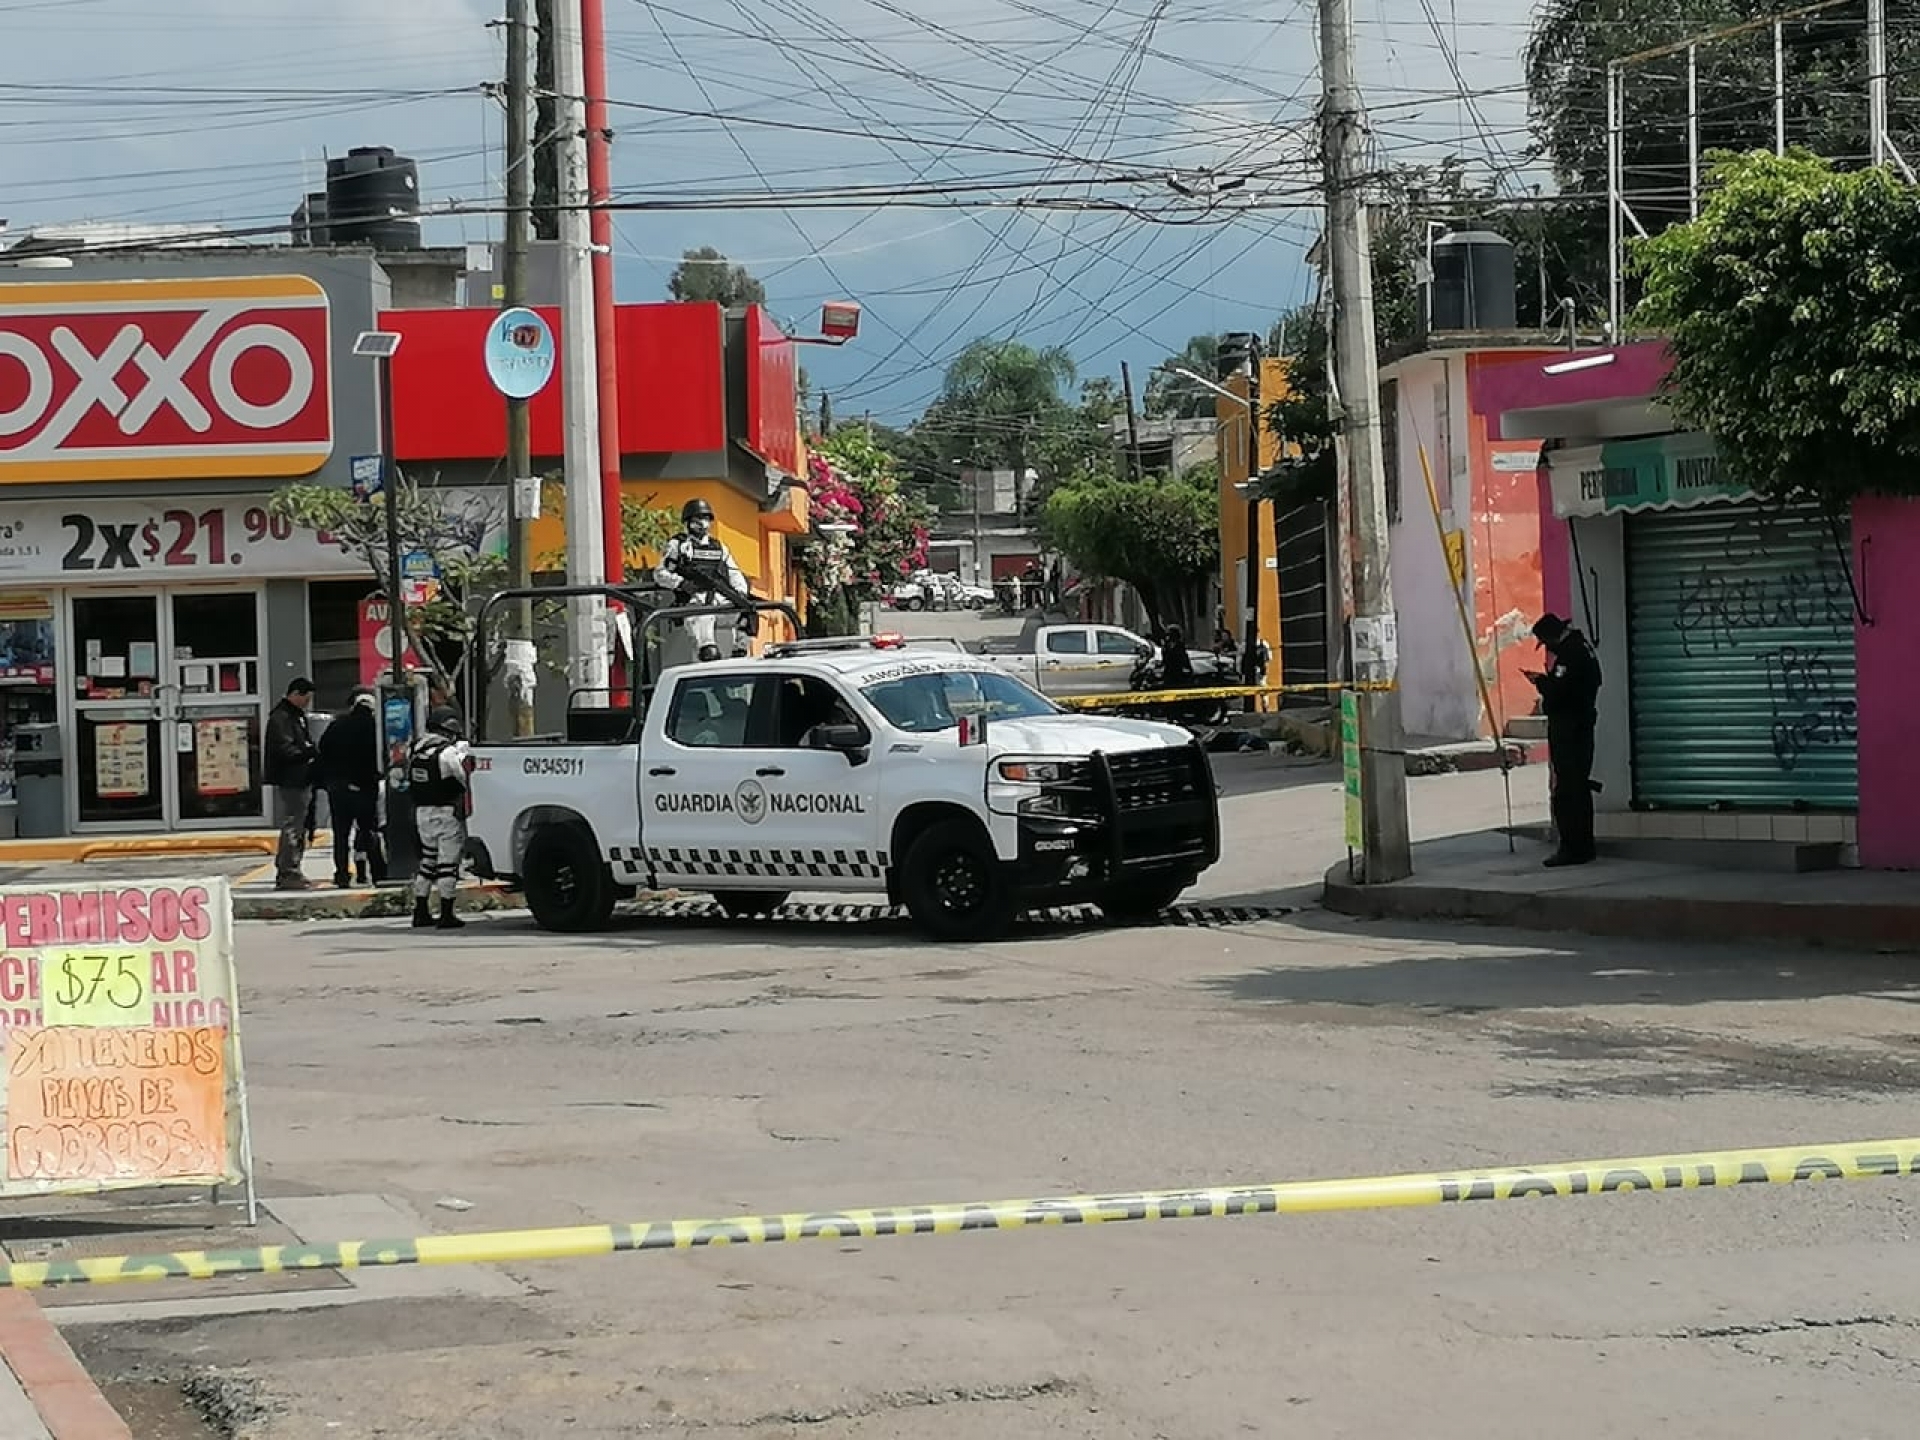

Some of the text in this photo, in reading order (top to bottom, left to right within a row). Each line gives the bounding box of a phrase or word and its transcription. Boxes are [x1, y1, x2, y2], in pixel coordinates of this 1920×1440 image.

[655, 793, 865, 814] GUARDIA NACIONAL
[0, 887, 211, 948] ERMISOS
[56, 953, 142, 1009] $75
[70, 1027, 219, 1075] TENEMOS
[41, 1076, 178, 1119] PLACAS DE
[13, 1118, 206, 1178] MORELOS
